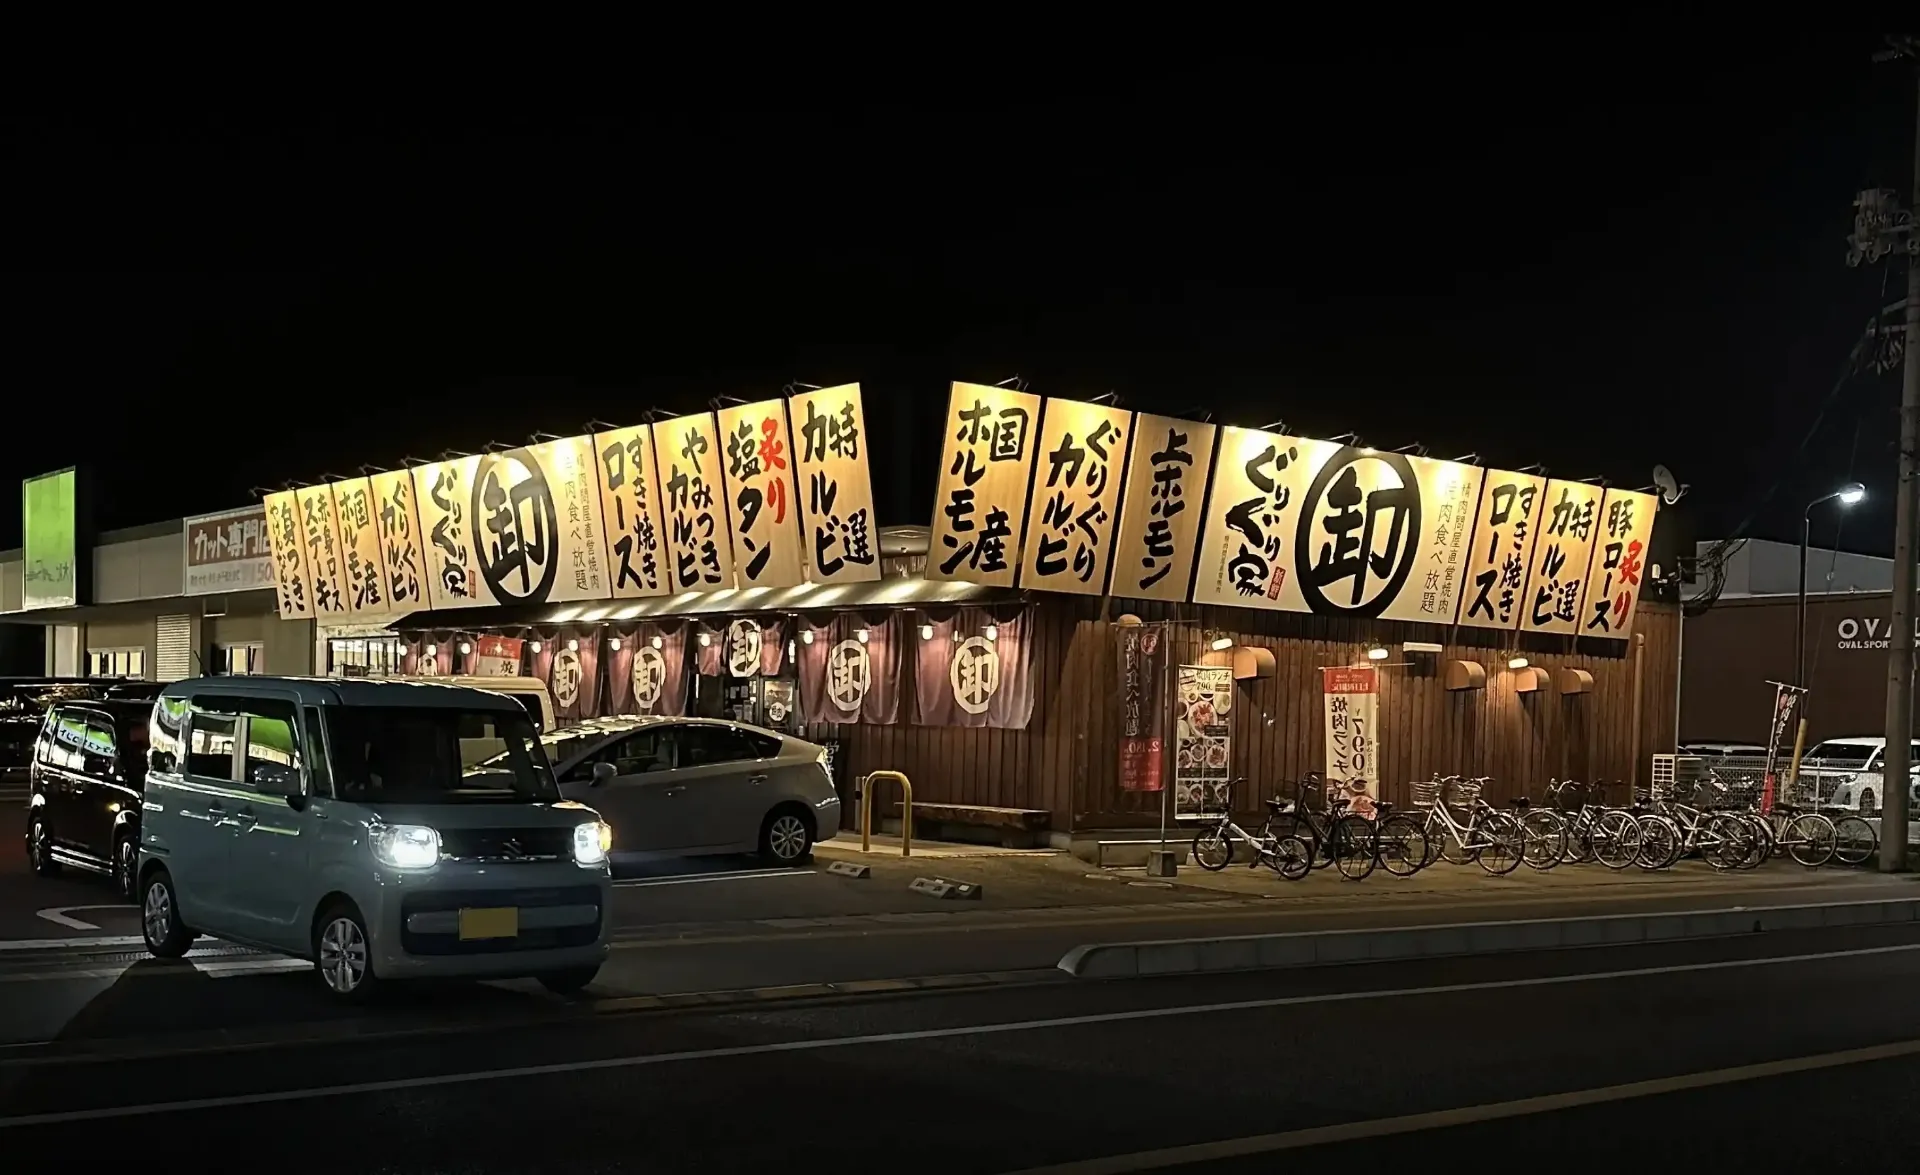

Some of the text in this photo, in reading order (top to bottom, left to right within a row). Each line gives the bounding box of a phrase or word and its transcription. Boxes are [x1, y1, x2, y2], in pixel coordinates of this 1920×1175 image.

[480, 467, 549, 596] 卸
[564, 455, 589, 591] 肉食べ放題
[602, 441, 643, 590] ロース
[626, 434, 658, 590] すき焼き
[666, 463, 700, 588] カルビ
[681, 426, 722, 584] やみつき
[727, 419, 771, 581] 塩タン
[757, 416, 787, 524] 炙り
[801, 399, 845, 576] カルビ
[828, 399, 875, 566] 特選
[939, 398, 992, 575] ホルモン
[969, 406, 1029, 573] 国産
[1035, 432, 1085, 576] カルビ
[1072, 419, 1122, 583] ぐりぐり
[1138, 427, 1193, 590] 上ホルモン
[1310, 463, 1411, 607] 卸
[303, 496, 330, 611] ステーキ
[316, 492, 345, 612] 赤身ロース
[340, 490, 363, 610] ホルモン
[354, 489, 381, 606] 国産
[379, 496, 407, 603] カルビ
[392, 481, 421, 603] ぐりぐり
[1467, 483, 1518, 621] ロース
[1498, 483, 1538, 623] すき焼き
[1532, 488, 1575, 626] カルビ
[1552, 497, 1596, 623] 特選
[1587, 498, 1634, 632] 豚ロース
[1613, 539, 1643, 630] 炙り
[1838, 640, 1891, 649] OVAL SPOR
